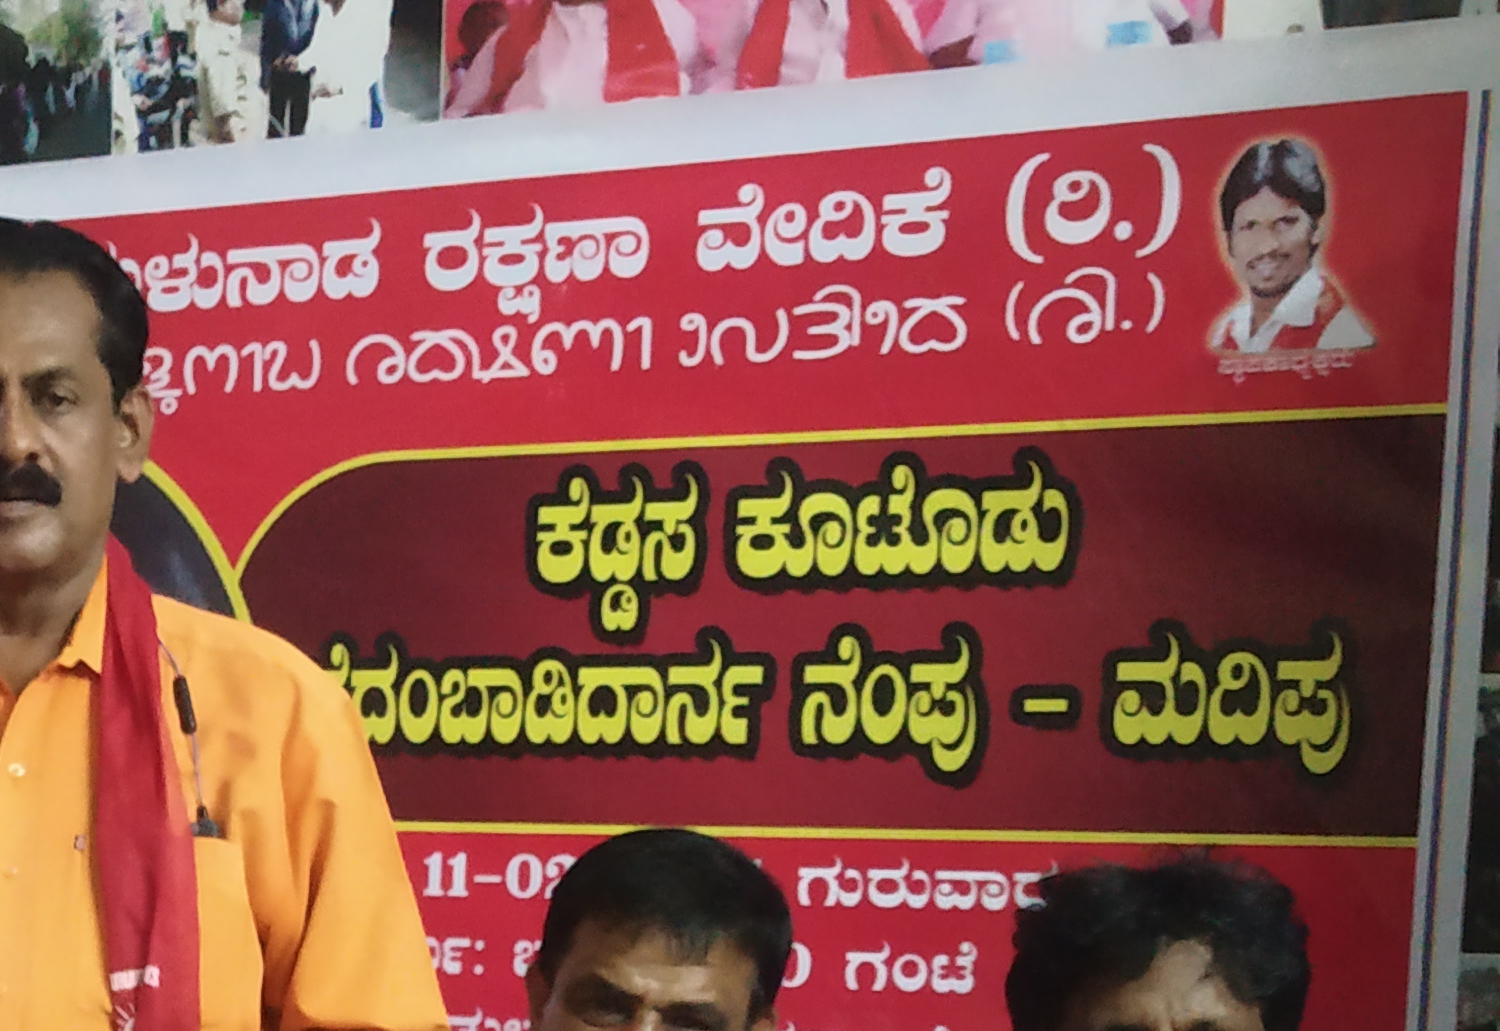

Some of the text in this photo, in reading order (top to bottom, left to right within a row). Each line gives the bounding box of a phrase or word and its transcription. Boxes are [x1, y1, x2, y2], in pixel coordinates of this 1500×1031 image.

[106, 142, 1182, 324] ಳುನಾಡ ರಕ್ಷಣಾ ವೇದಿಕೆ (ರಿ.)
[534, 473, 700, 633] ಕೆಡ್ಡಸ
[801, 634, 978, 772] ನೆಂಪು
[1112, 631, 1354, 775] ಮದಿಪು
[843, 941, 979, 994] ಗಂಟೆ
